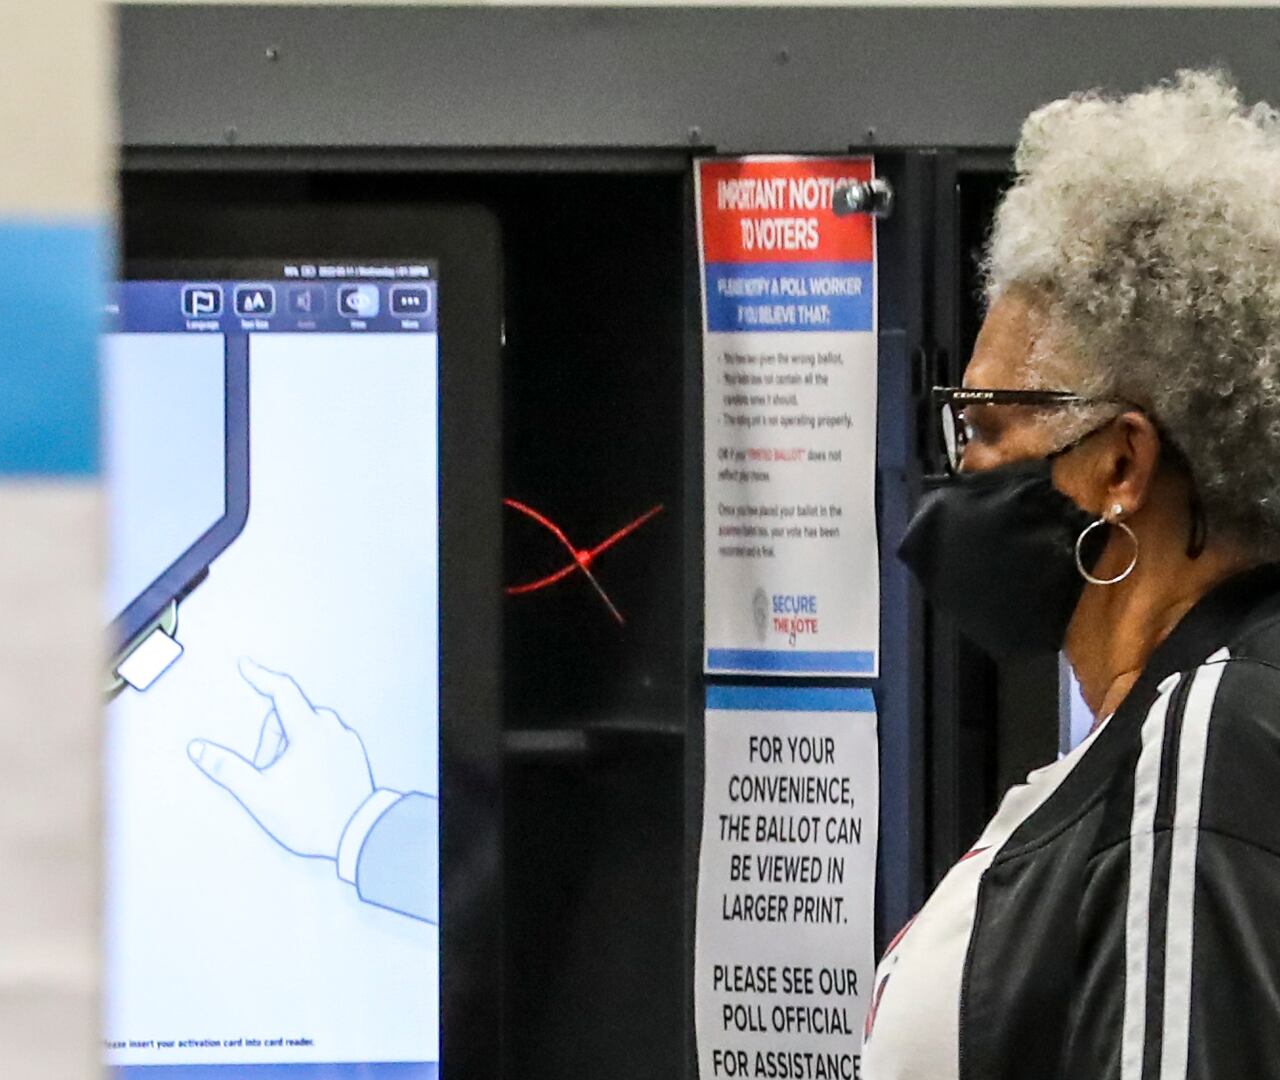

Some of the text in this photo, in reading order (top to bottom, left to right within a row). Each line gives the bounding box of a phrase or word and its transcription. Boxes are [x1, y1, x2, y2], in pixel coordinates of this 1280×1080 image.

[789, 178, 859, 209] NOTI
[757, 218, 819, 250] VOTERS
[810, 277, 862, 294] WORKER
[773, 596, 816, 613] SECURE
[749, 736, 835, 764] FOR YOUR
[729, 776, 855, 809] CONVENIENCE,
[720, 815, 862, 844] THE BALLOT CAN
[731, 855, 844, 883] BE VIEWED IN
[722, 895, 847, 924] LARGER PRINT.
[713, 965, 858, 996] PLEASE SEE OUR
[723, 1005, 852, 1035] POLL OFFICIAL
[157, 1040, 175, 1050] your
[178, 1039, 220, 1048] activation
[223, 1038, 242, 1047] card
[264, 1038, 282, 1047] card
[713, 1050, 749, 1077] FOR
